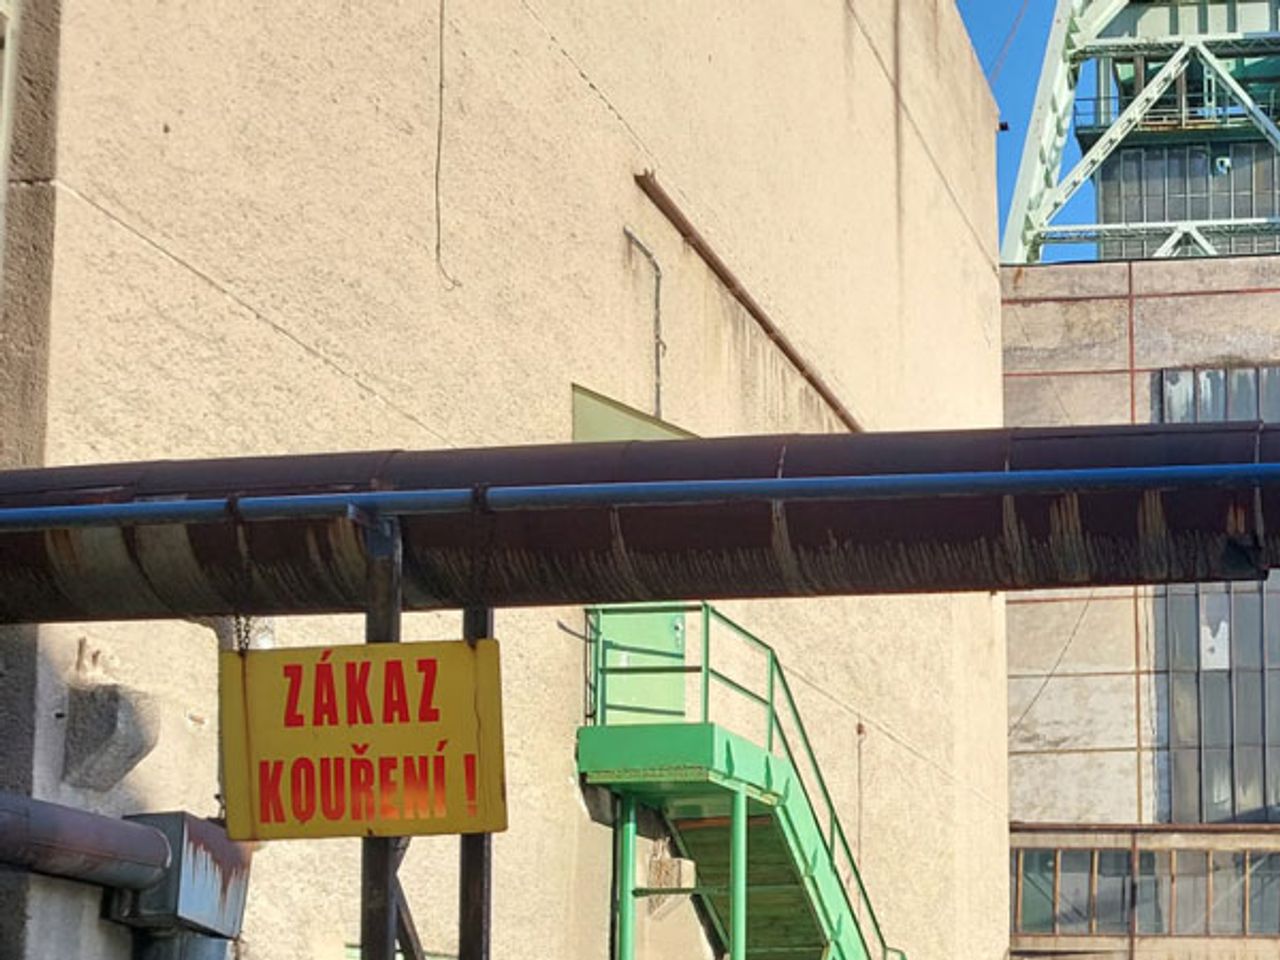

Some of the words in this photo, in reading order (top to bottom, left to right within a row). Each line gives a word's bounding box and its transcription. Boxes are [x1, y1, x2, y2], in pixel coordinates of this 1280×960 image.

[282, 649, 441, 728] ZÁKAZ
[258, 740, 448, 824] KOUŘENÍ
[463, 754, 479, 818] !
